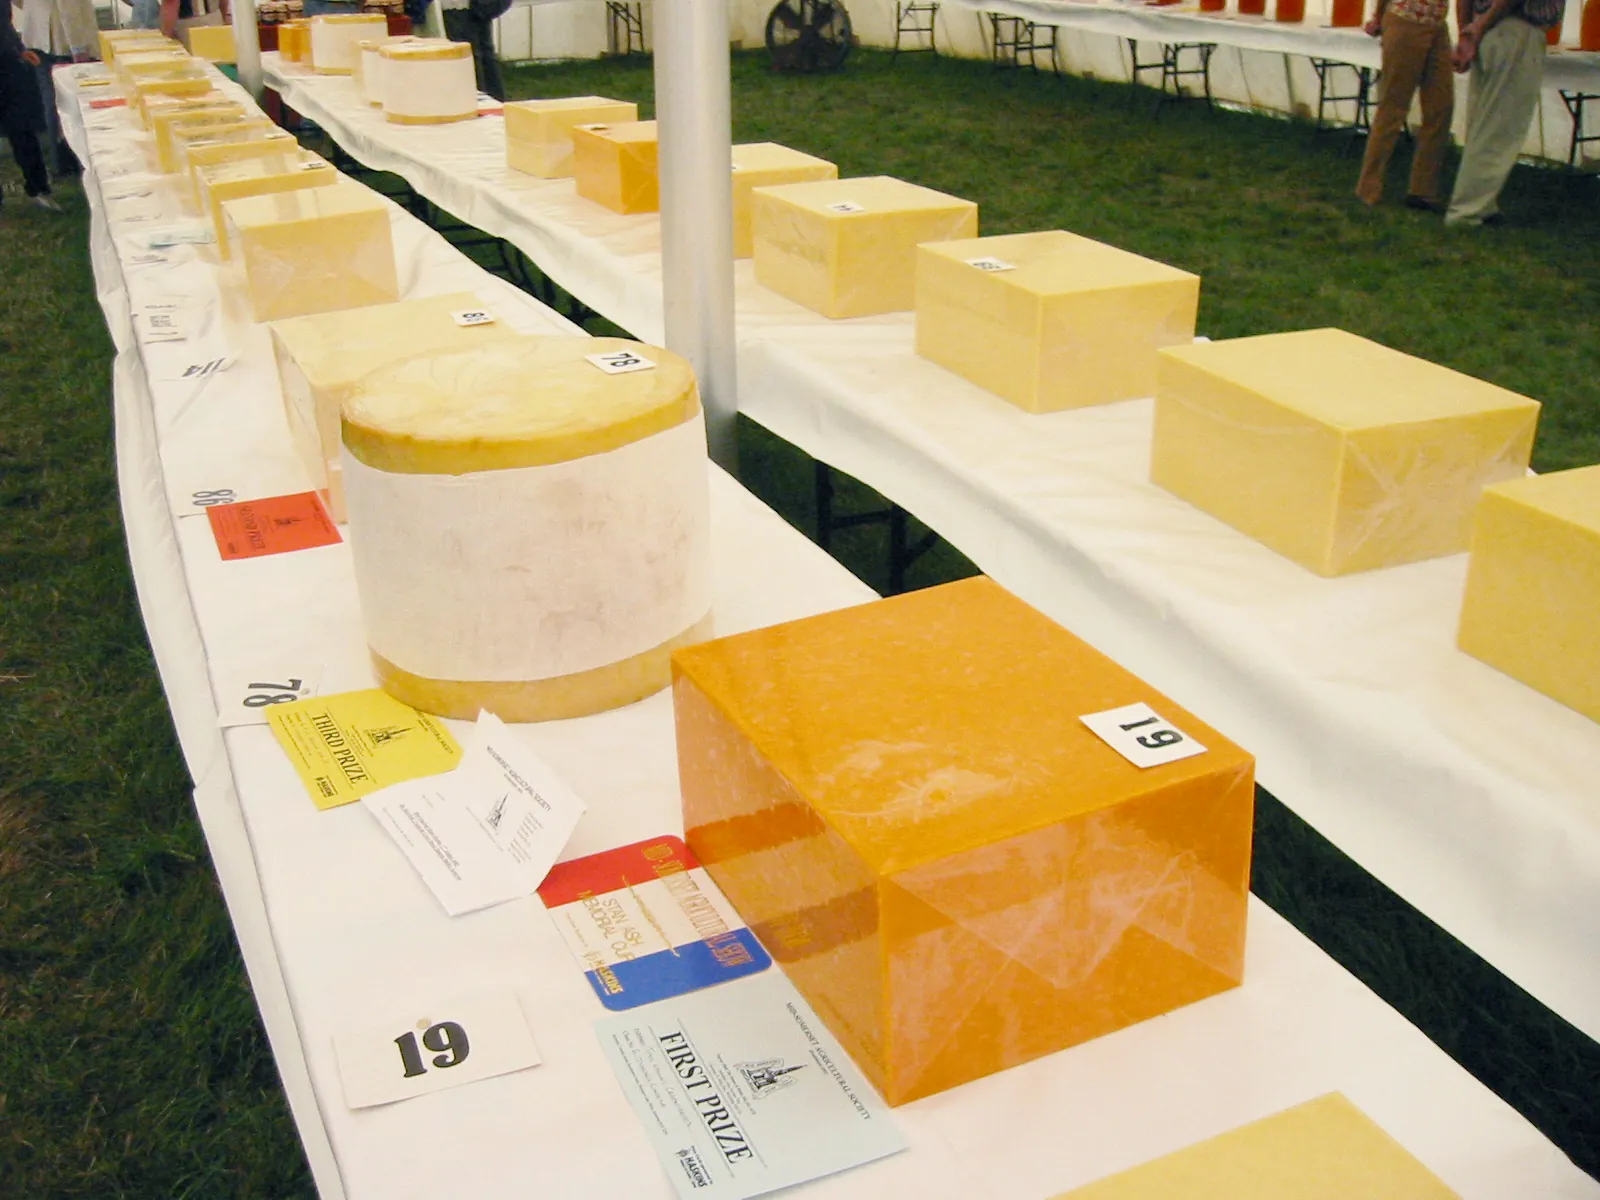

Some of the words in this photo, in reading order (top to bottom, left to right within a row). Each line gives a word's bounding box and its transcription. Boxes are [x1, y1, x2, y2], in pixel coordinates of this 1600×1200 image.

[602, 353, 641, 368] 78
[192, 488, 235, 506] 86
[243, 678, 302, 708] 78
[312, 713, 346, 748] THIRD
[333, 748, 369, 784] PRIZE
[1118, 716, 1184, 749] 19
[576, 889, 618, 940] MEMORIAL
[602, 897, 629, 926] STAN
[623, 926, 645, 947] ASH
[394, 1021, 470, 1078] 19
[659, 1030, 703, 1091] FIRST
[695, 1093, 754, 1164] PRIZE
[847, 1092, 871, 1120] SOCIETY
[686, 1156, 709, 1188] HASKINS
